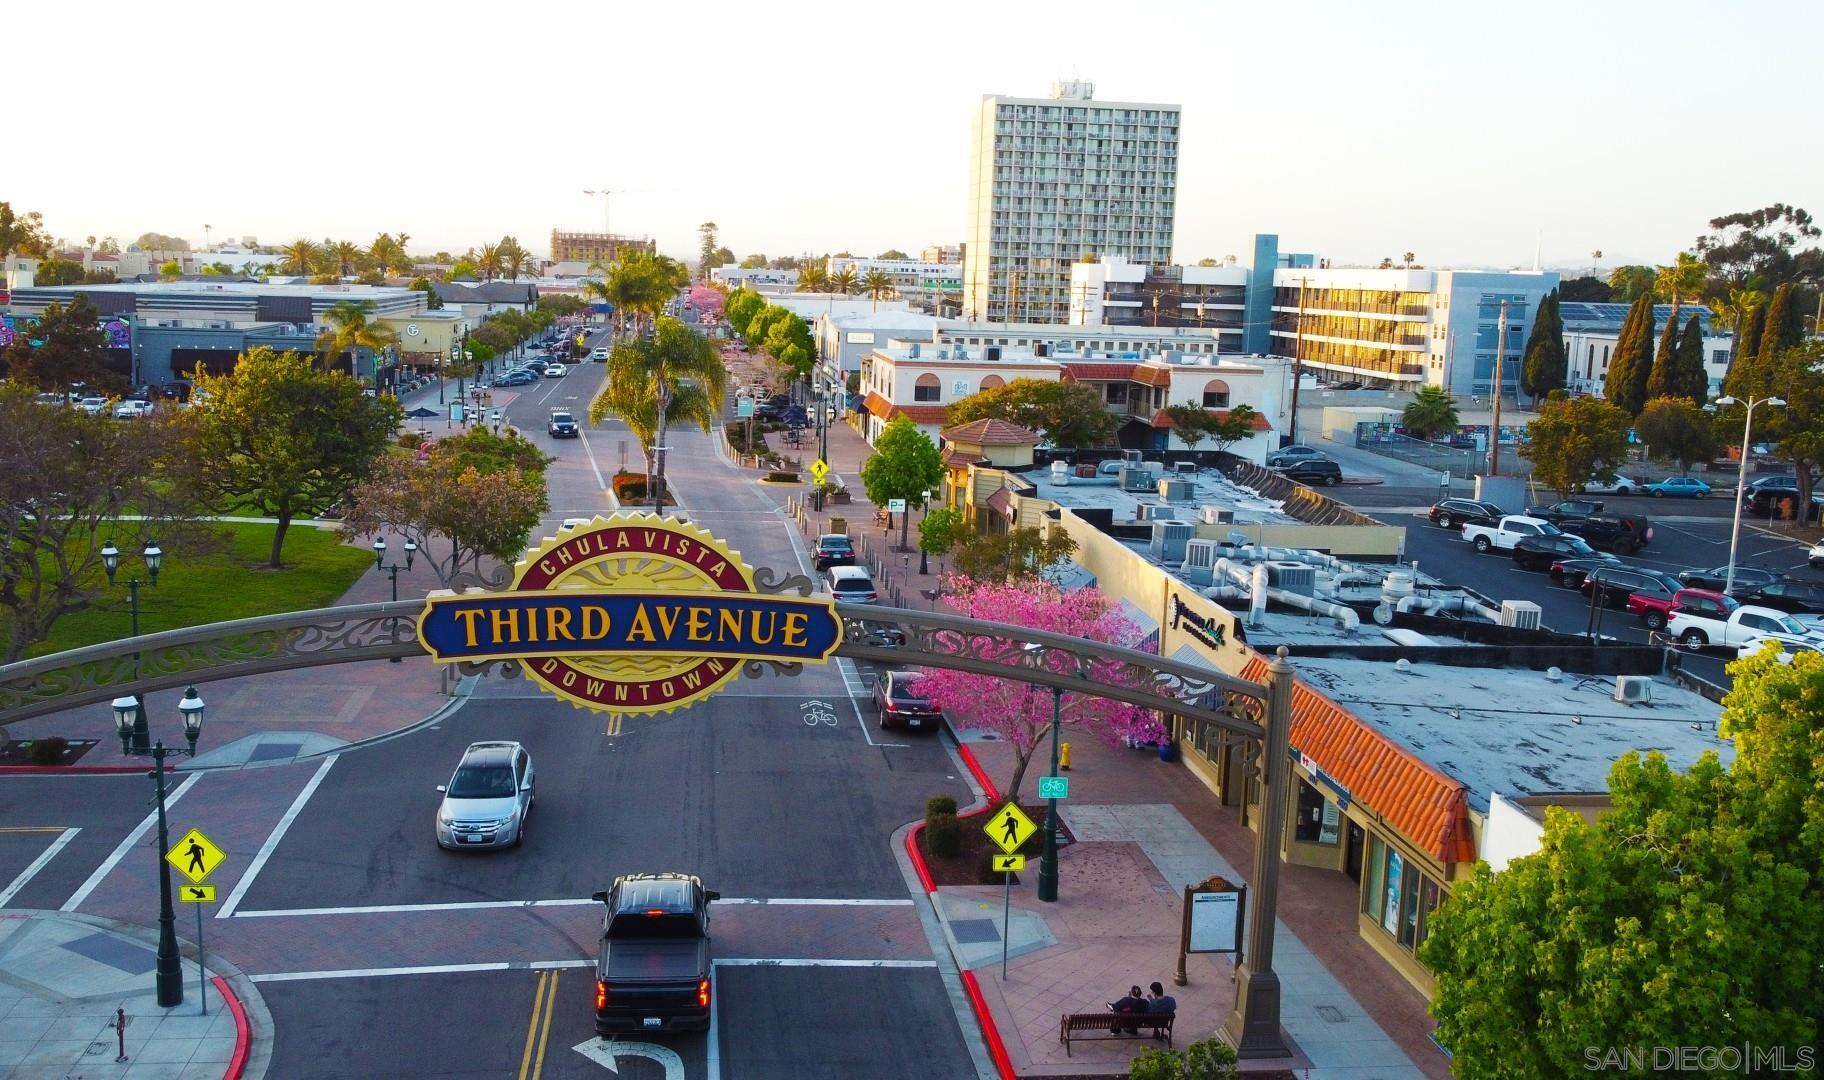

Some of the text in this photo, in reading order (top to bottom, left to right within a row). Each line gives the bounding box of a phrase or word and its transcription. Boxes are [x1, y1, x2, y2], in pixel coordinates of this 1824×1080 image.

[540, 531, 726, 578] CHULA VISTA
[454, 602, 808, 648] THIRD AVENUE
[541, 658, 725, 701] DOWNTOWN
